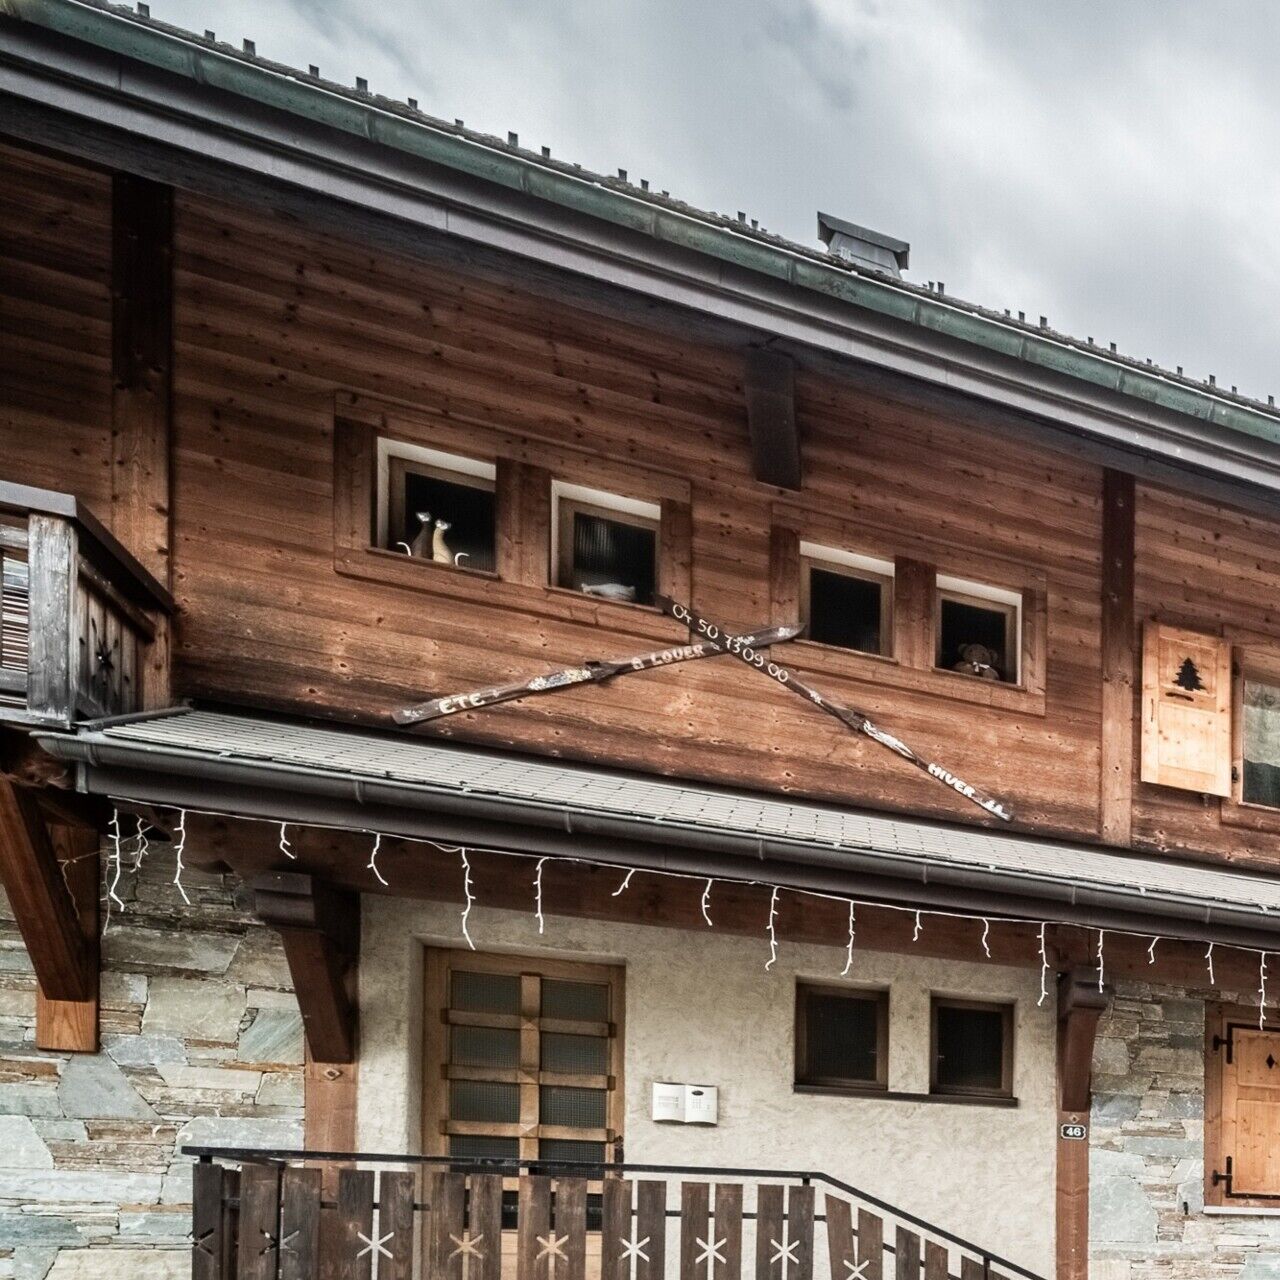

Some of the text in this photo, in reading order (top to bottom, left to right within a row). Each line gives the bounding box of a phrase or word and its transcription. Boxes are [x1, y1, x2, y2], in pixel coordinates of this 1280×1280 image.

[650, 645, 704, 666] LOUER
[672, 603, 789, 683] 04 50 73 09 00
[928, 763, 976, 798] HIVER
[1066, 1127, 1082, 1137] 46
